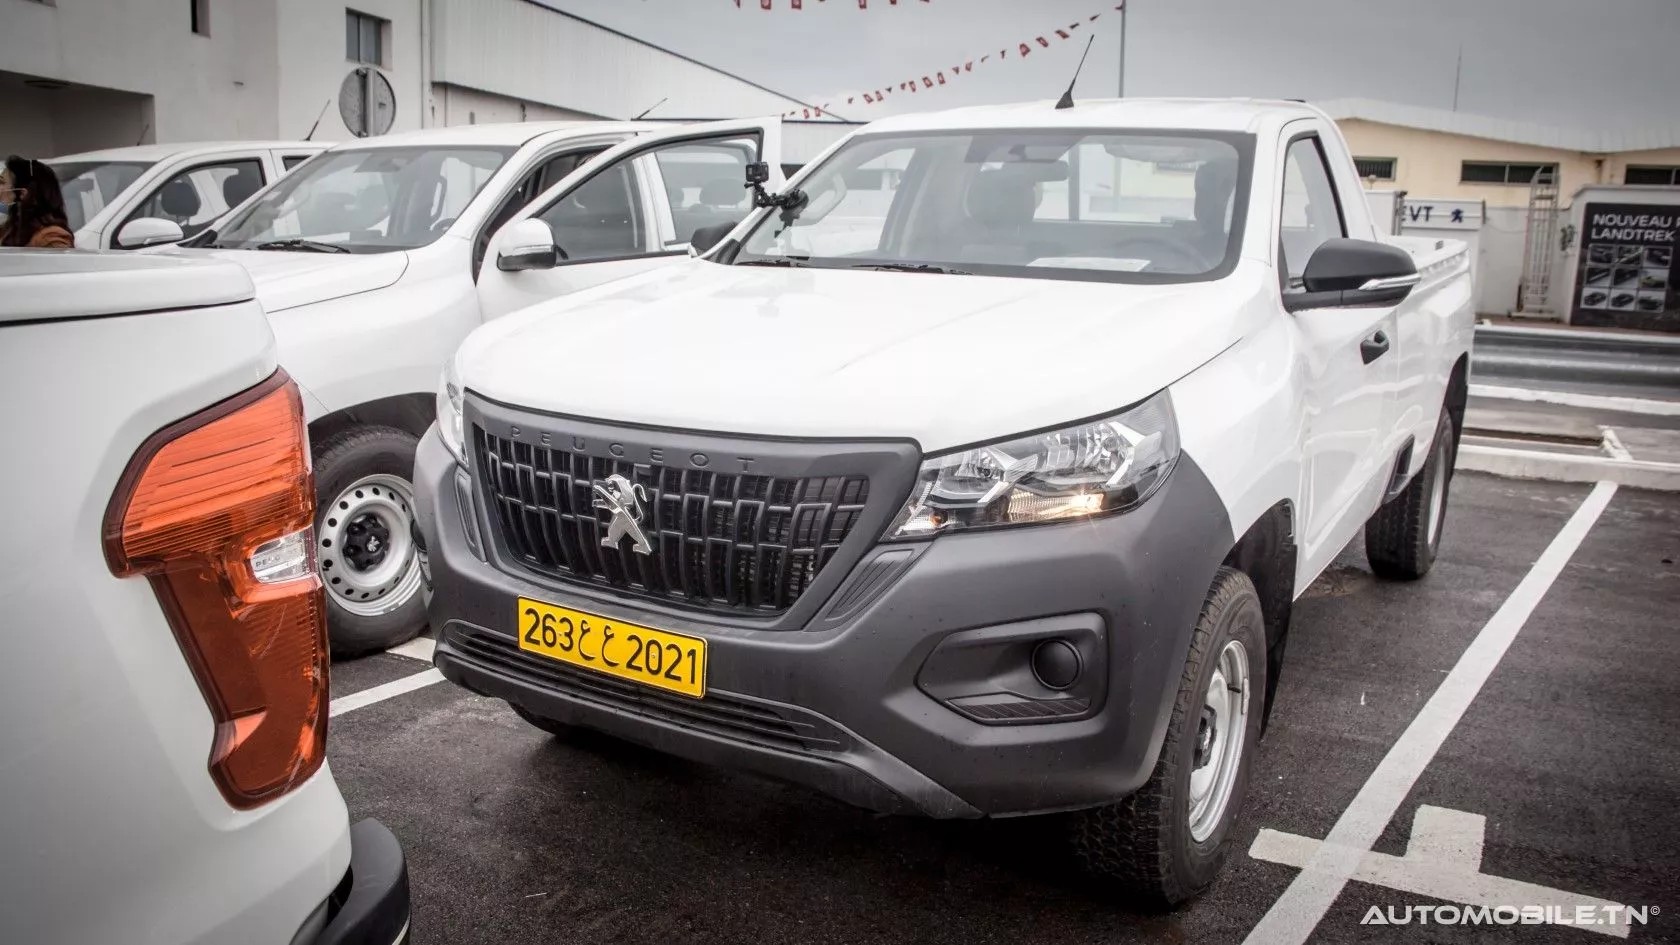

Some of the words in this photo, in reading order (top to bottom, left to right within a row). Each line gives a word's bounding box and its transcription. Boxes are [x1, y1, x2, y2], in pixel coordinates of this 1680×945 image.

[1591, 228, 1676, 242] LANDTREK
[1592, 213, 1673, 228] NOUVEAU
[510, 425, 755, 473] PEUGEOT
[524, 607, 574, 652] 263
[625, 634, 702, 684] 2021
